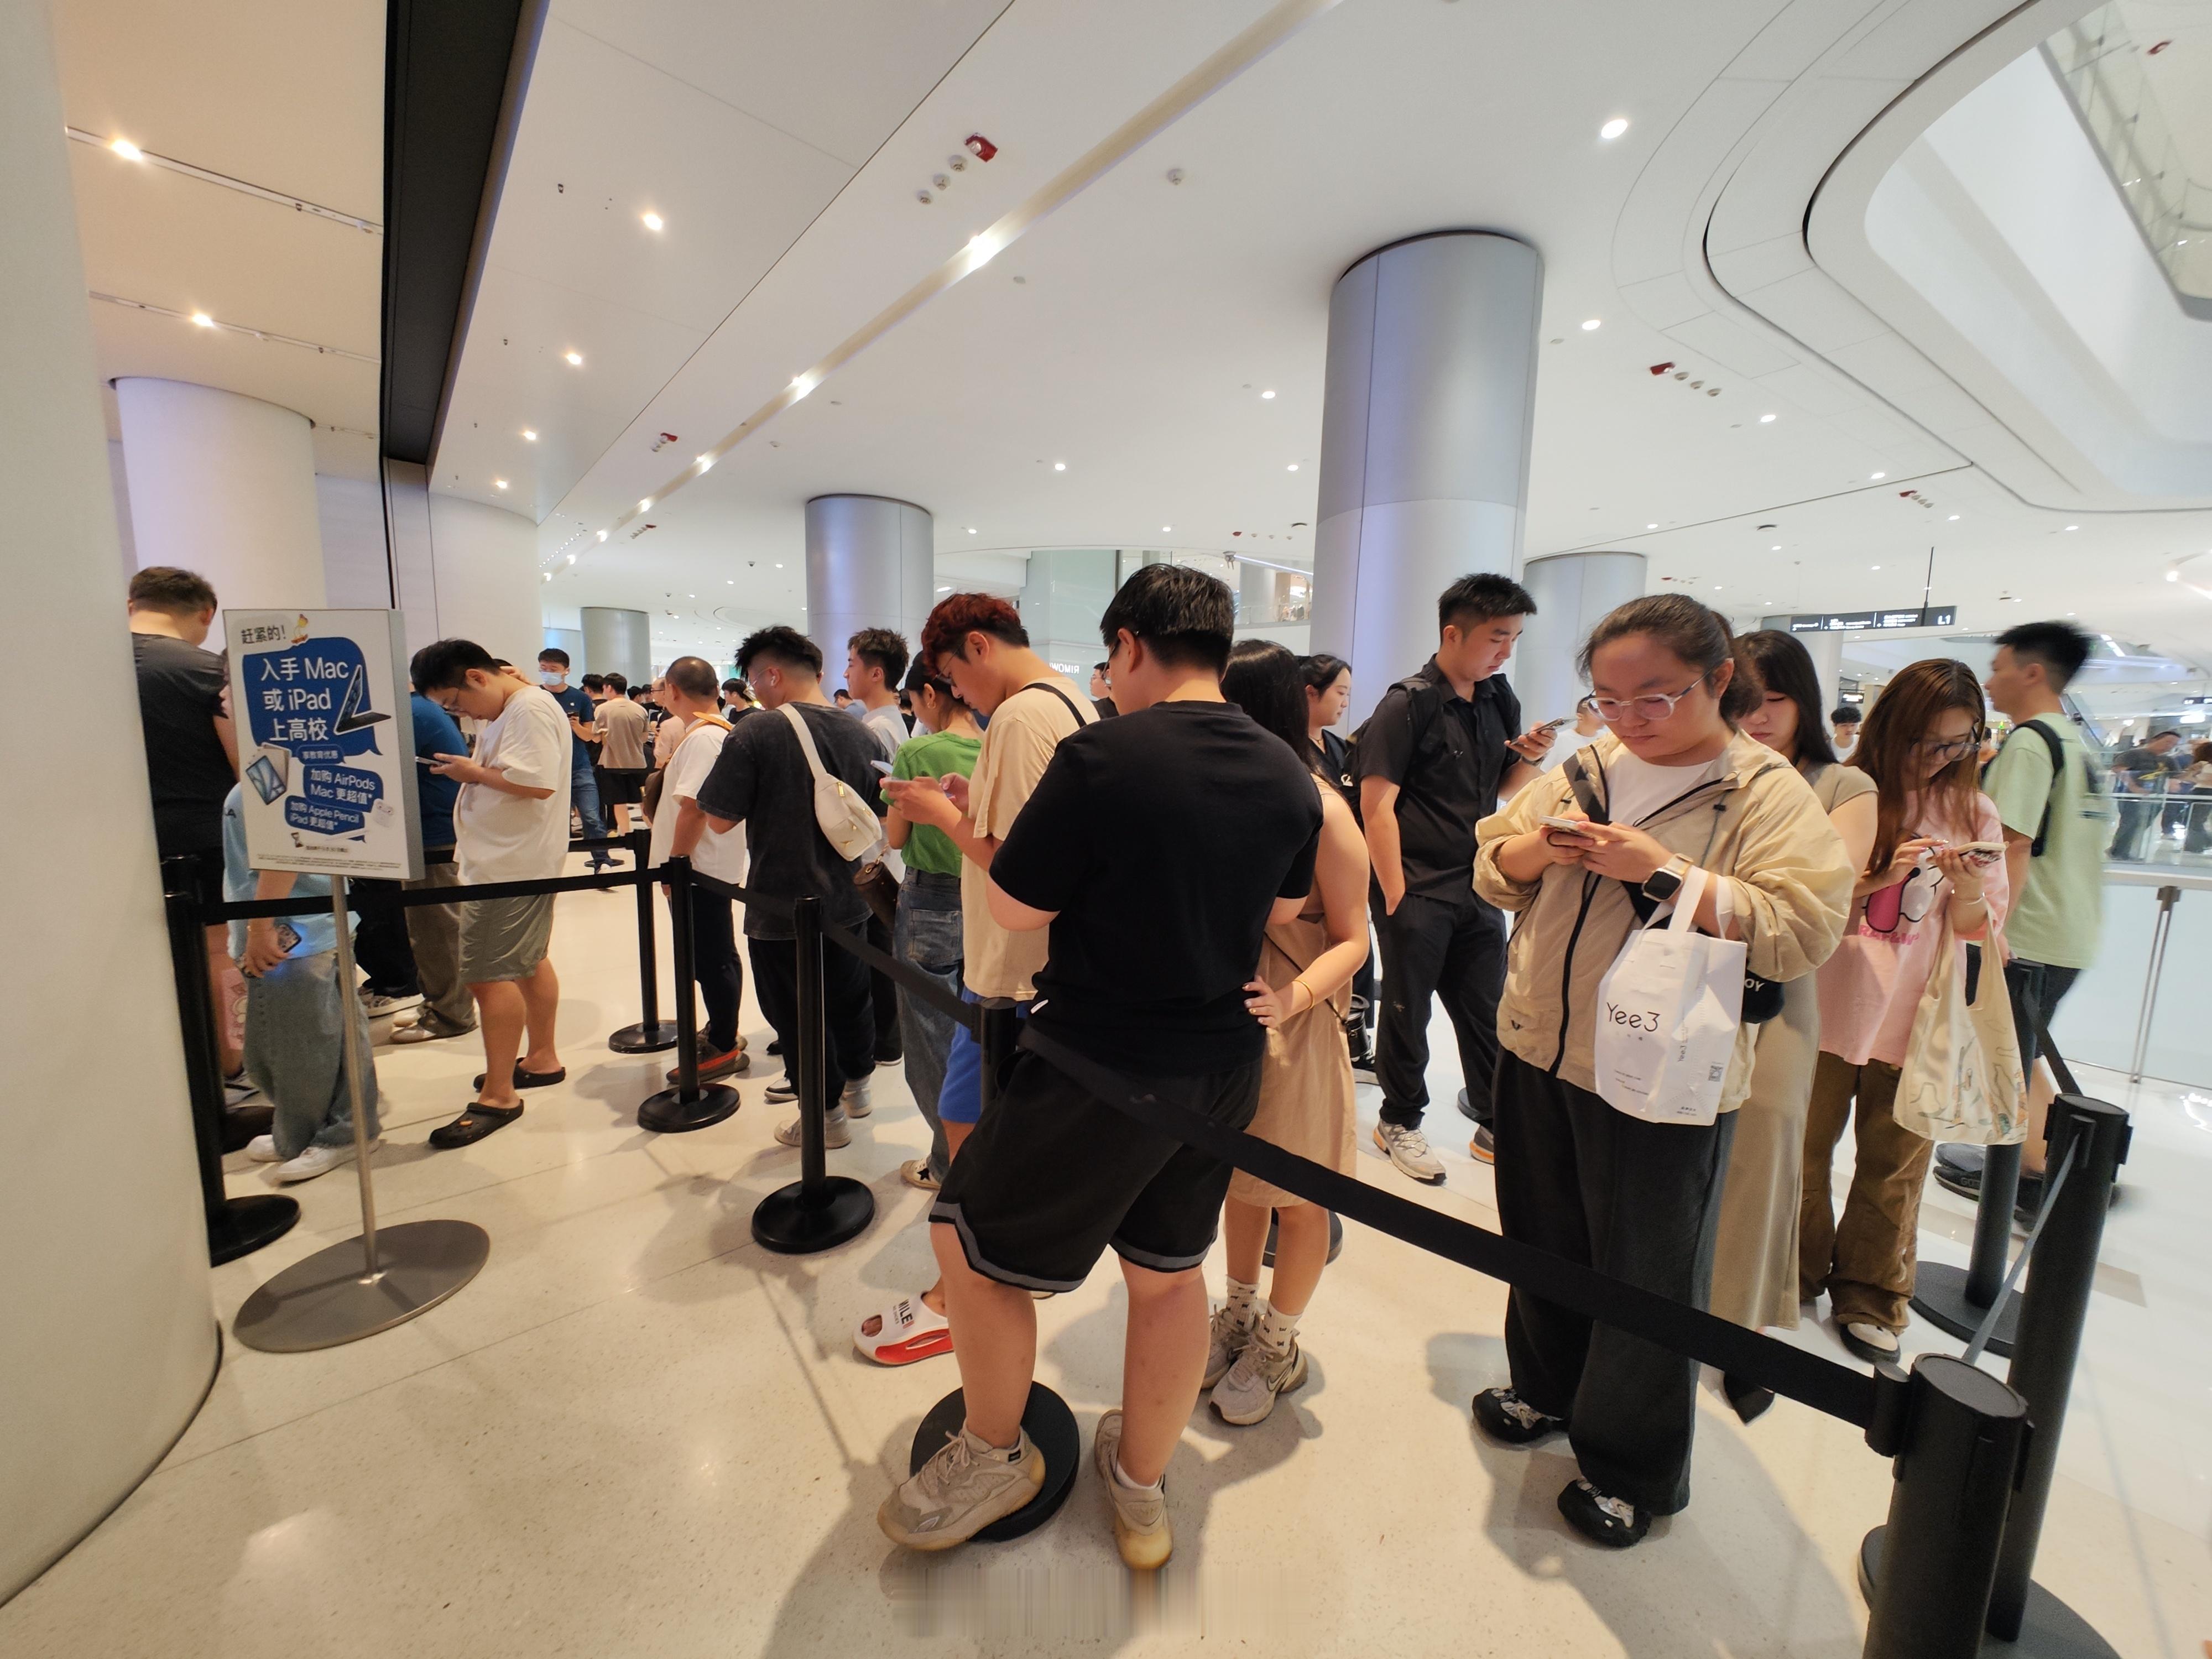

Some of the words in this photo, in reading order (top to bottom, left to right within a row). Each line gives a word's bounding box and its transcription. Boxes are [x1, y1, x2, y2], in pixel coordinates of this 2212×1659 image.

[1937, 614, 1951, 625] L1
[261, 658, 300, 681] 入手
[305, 656, 349, 680] Mac
[262, 689, 285, 712] 或
[289, 688, 331, 711] iPad
[269, 718, 330, 742] 上高校
[311, 769, 332, 783] 加购
[334, 773, 375, 790] AirPods
[310, 784, 334, 798] Mac
[290, 813, 308, 825] iPad
[309, 806, 333, 818] Apple
[334, 810, 359, 823] Pencil
[1606, 1002, 1661, 1032] Yee3
